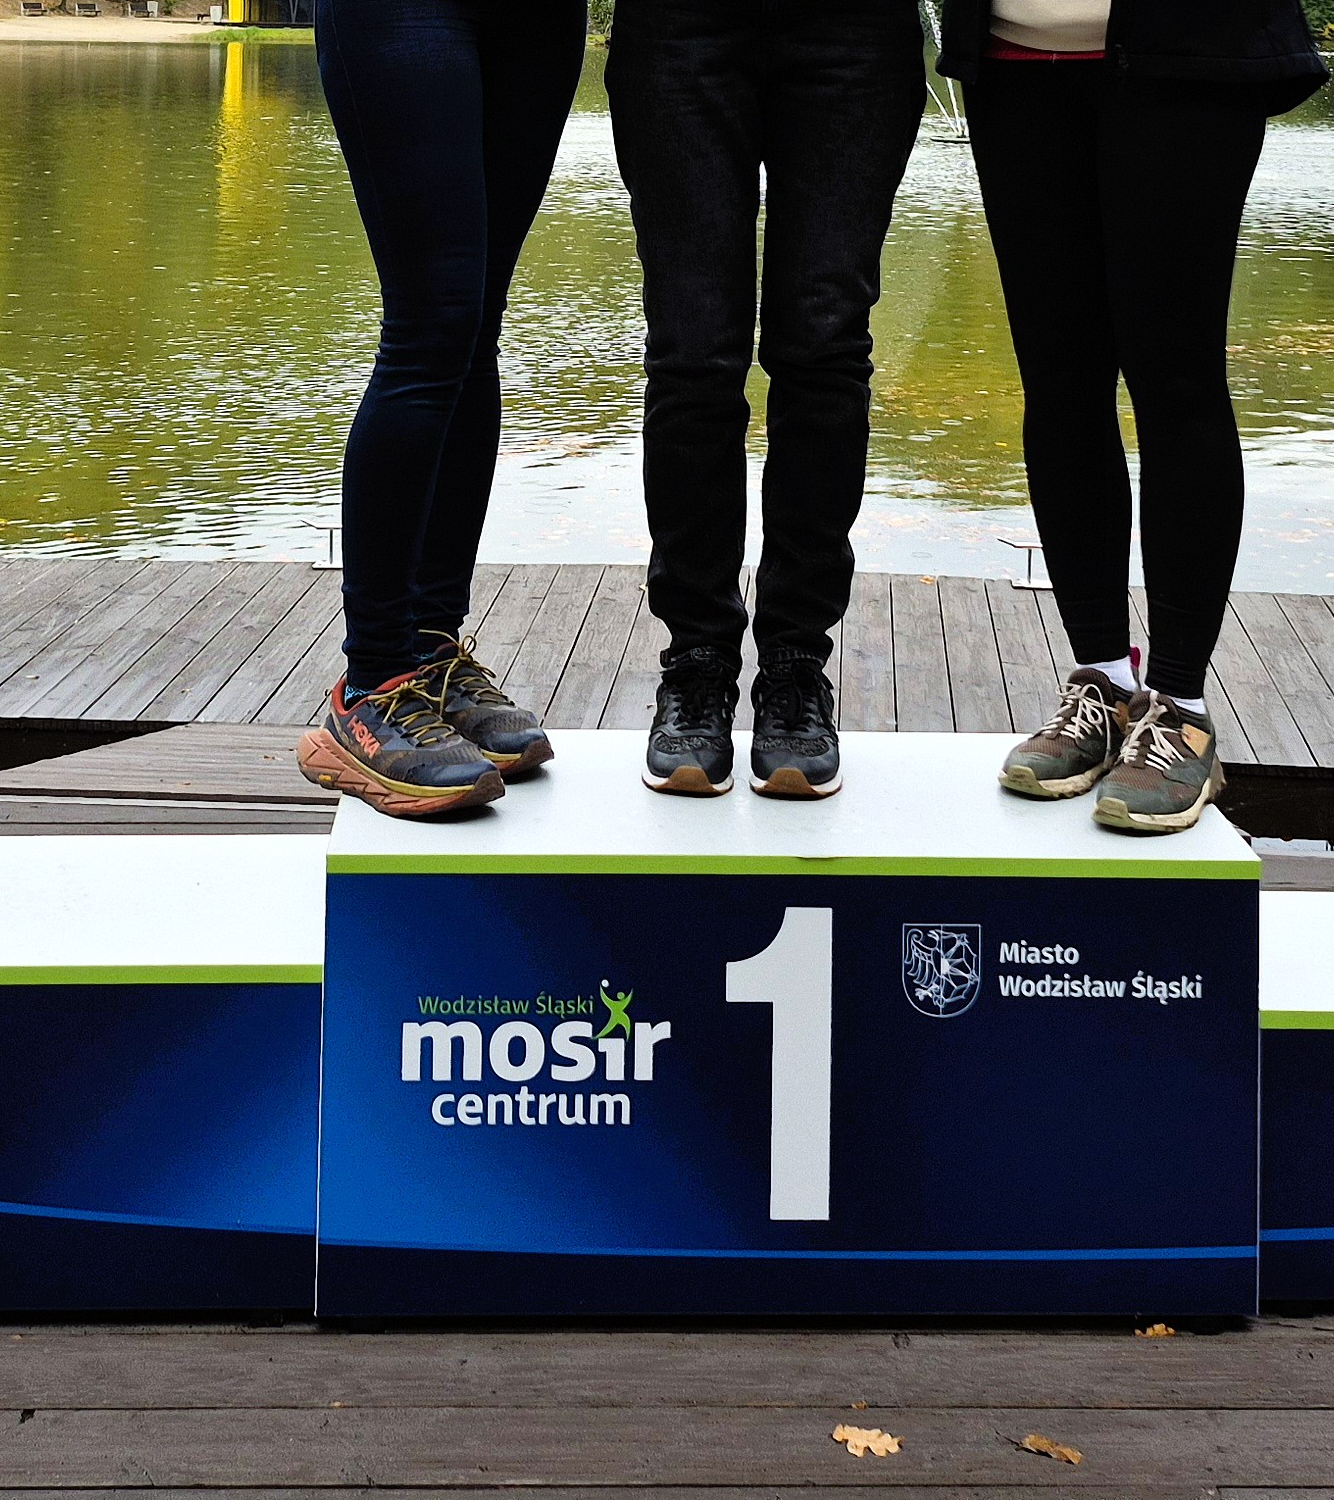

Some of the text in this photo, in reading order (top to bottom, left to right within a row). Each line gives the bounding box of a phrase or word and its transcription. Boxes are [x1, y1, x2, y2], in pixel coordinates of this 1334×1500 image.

[347, 715, 380, 758] HOKA
[999, 939, 1080, 965] Miasto
[418, 991, 595, 1019] Wodzisław Śląski
[998, 970, 1203, 1005] Wodzisław Śląski
[402, 1020, 672, 1082] mosir
[726, 907, 833, 1220] 1
[431, 1085, 631, 1126] centrum
